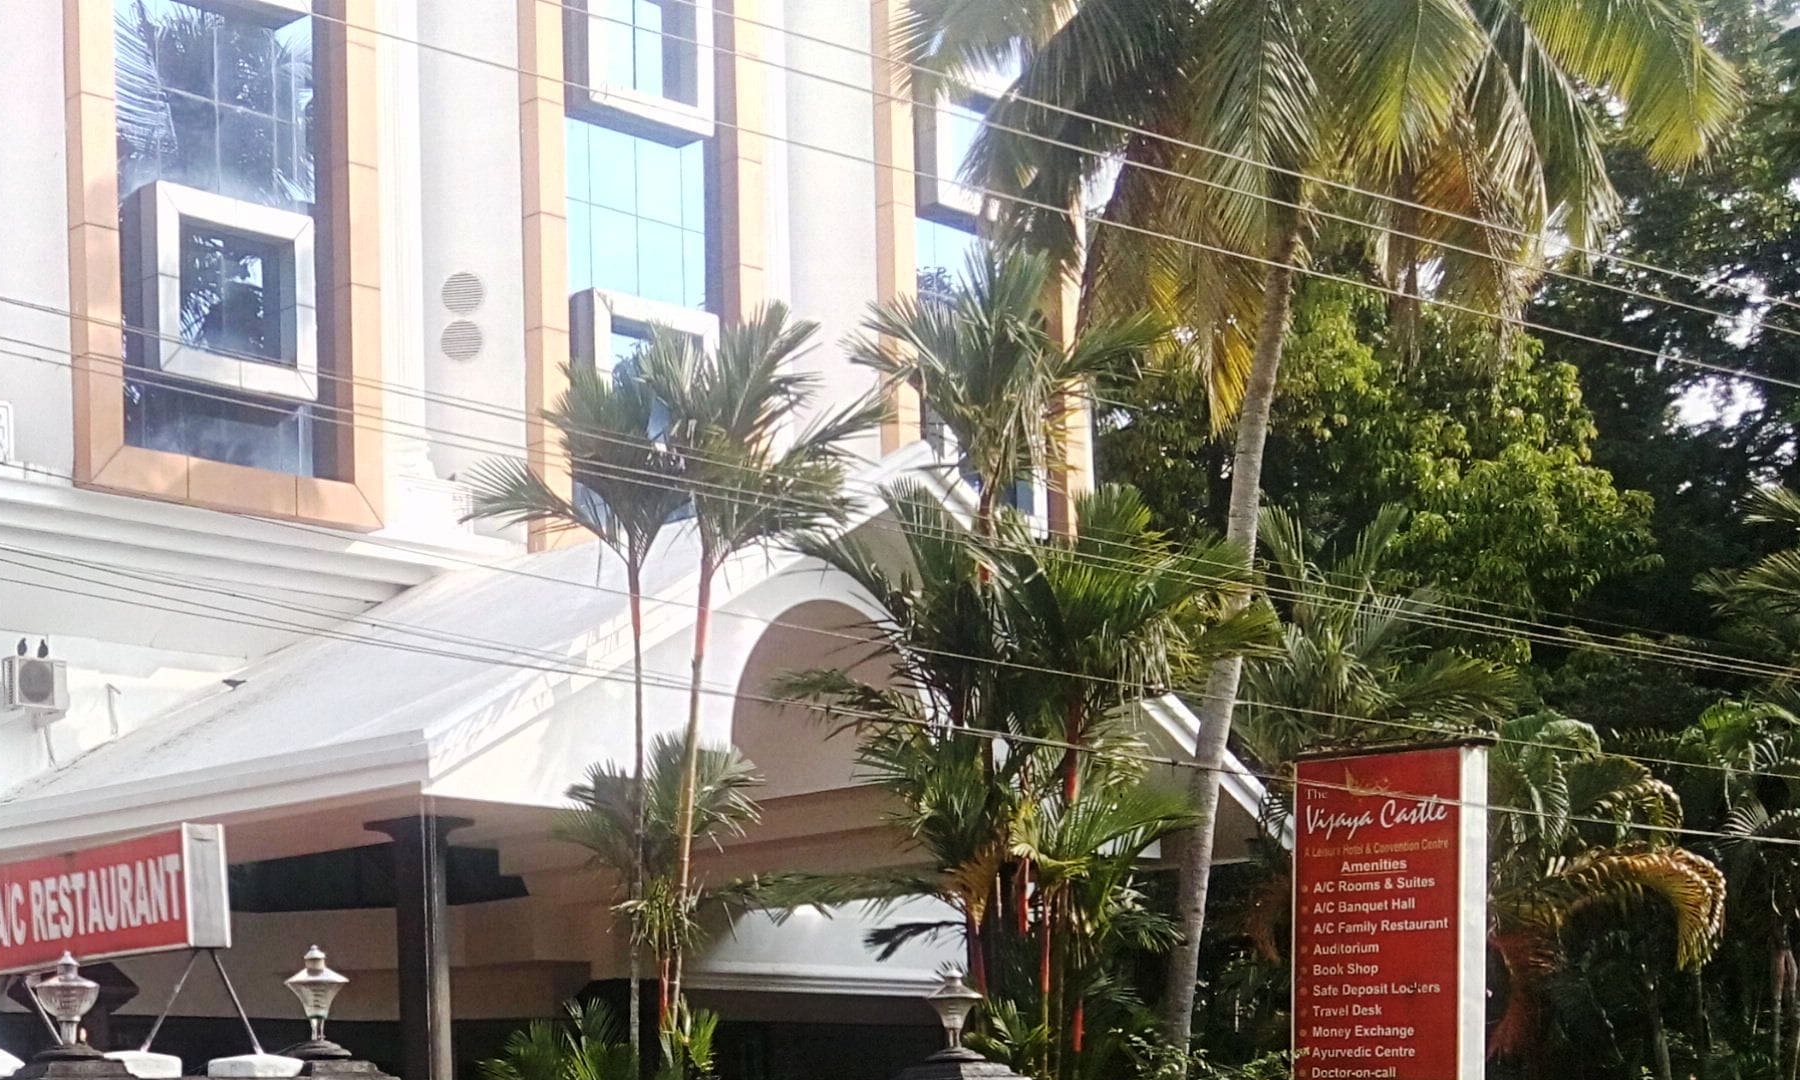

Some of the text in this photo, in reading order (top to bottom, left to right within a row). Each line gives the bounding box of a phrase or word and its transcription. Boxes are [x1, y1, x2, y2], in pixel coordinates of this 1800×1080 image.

[1305, 788, 1329, 800] The
[1306, 794, 1447, 840] Vijaya Castle
[1373, 841, 1419, 854] Convention
[1421, 838, 1449, 850] Centre
[1341, 859, 1407, 873] Amenities
[1313, 877, 1435, 894] A/C Rooms & Suites
[28, 853, 183, 943] RESTAURANT
[1313, 898, 1416, 914] A/C Banquet Hall
[1313, 917, 1449, 935] A/C Family Restaurant
[1313, 942, 1380, 955] Auditorium
[1312, 962, 1379, 976] Book Shop
[1312, 984, 1338, 997] Safe
[1342, 983, 1388, 997] Deposit
[1312, 1004, 1383, 1017] Travel Desk
[1312, 1025, 1415, 1039] Money Exchange
[1312, 1045, 1416, 1060] Ayurvedic Centre
[1312, 1066, 1396, 1079] Doctor-on-call
